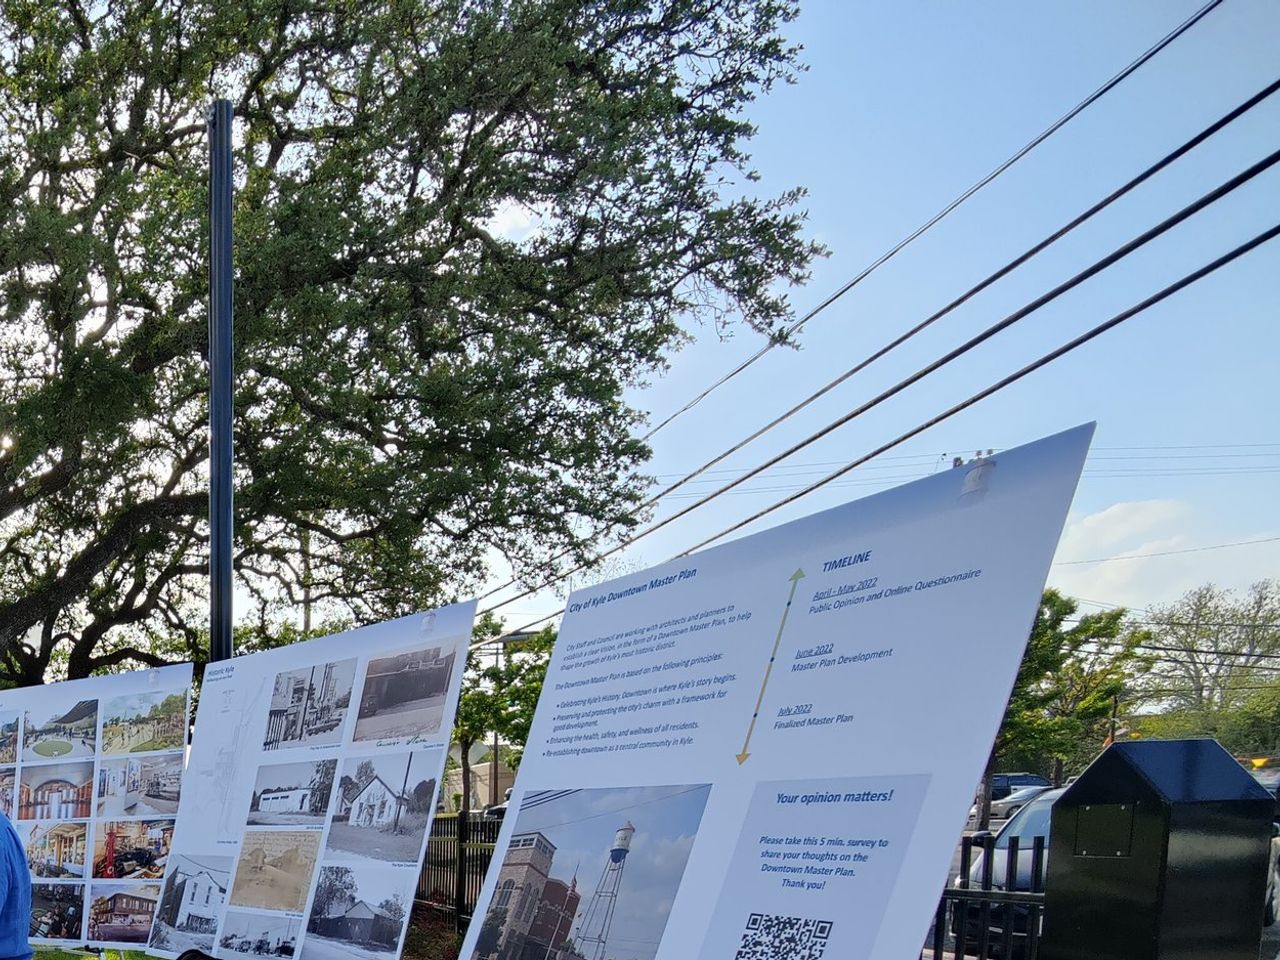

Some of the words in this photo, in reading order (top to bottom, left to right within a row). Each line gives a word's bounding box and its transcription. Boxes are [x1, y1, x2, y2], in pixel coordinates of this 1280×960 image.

[822, 550, 872, 573] TIMELINE
[569, 603, 583, 613] City
[583, 600, 592, 610] of
[591, 596, 606, 608] Kyle
[607, 583, 648, 602] Downtown
[648, 573, 677, 590] Master
[678, 568, 698, 581] Plan
[808, 600, 832, 615] Public
[833, 595, 865, 611] Opinion
[866, 591, 883, 602] and
[884, 584, 913, 598] Online
[914, 568, 982, 591] Questionnaire
[812, 588, 832, 602] April
[837, 582, 856, 597] May
[856, 577, 878, 592] 2022
[615, 632, 624, 640] are
[624, 627, 646, 638] working
[646, 623, 658, 632] with
[658, 617, 686, 629] architects
[687, 612, 700, 622] and
[699, 606, 726, 620] planners
[726, 604, 735, 612] to
[622, 640, 632, 648] the
[632, 637, 646, 646] form
[646, 633, 653, 643] of
[657, 627, 689, 640] Downtown
[689, 622, 711, 633] Master
[736, 611, 752, 621] help
[791, 660, 818, 672] Master
[819, 658, 836, 668] Plan
[837, 648, 893, 665] Development
[795, 649, 814, 660] June
[814, 643, 835, 656] 2022
[564, 679, 590, 690] Downtown
[590, 675, 609, 684] Master
[625, 667, 643, 678] based
[651, 664, 662, 673] the
[662, 659, 690, 671] following
[560, 698, 587, 709] Celebrating
[621, 687, 652, 699] Downtown
[658, 684, 677, 693] where
[677, 680, 695, 691] Kyle's
[695, 678, 712, 688] story
[556, 712, 581, 721] Preserving
[581, 710, 591, 718] and
[590, 706, 617, 718] protecting
[617, 705, 627, 713] the
[642, 700, 661, 709] charm
[661, 697, 676, 706] with
[681, 691, 716, 703] framework
[716, 689, 727, 698] for
[777, 705, 793, 718] July
[793, 703, 813, 714] 2022
[618, 729, 629, 737] and
[629, 726, 653, 736] wellness
[653, 724, 661, 733] of
[661, 723, 669, 732] all
[773, 718, 806, 730] Finalized
[806, 716, 835, 726] Master
[835, 713, 854, 723] Plan
[546, 748, 581, 756] Re-establishing
[580, 745, 608, 754] downtown
[619, 741, 639, 750] central
[638, 739, 673, 748] community
[776, 793, 799, 804] Your
[800, 791, 841, 805] opinion
[843, 789, 894, 803] matters!
[759, 836, 784, 845] Please
[784, 836, 802, 845] take
[803, 837, 818, 846] this
[819, 837, 825, 846] 5
[826, 837, 845, 847] min.
[847, 839, 877, 849] survey
[878, 839, 888, 847] to
[760, 850, 781, 859] share
[782, 852, 801, 861] your
[801, 851, 838, 862] thoughts
[839, 853, 851, 862] on
[852, 852, 869, 862] the
[760, 863, 803, 874] Downtown
[804, 865, 833, 876] Master
[834, 867, 856, 877] Plan.
[781, 878, 805, 888] Thank
[806, 881, 827, 891] you!
